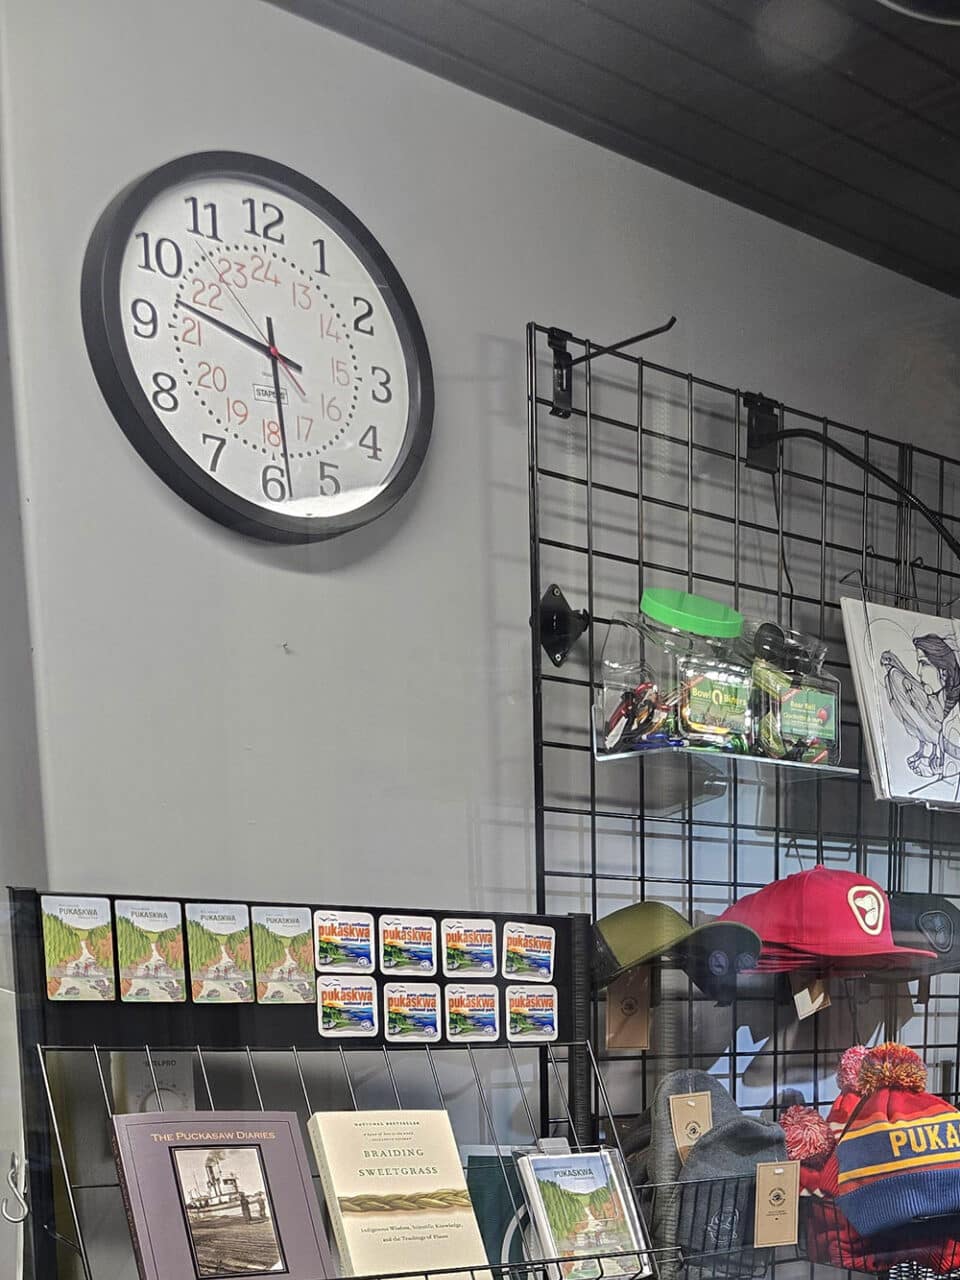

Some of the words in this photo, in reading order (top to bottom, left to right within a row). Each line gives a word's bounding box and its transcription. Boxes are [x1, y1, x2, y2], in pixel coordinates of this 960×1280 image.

[184, 195, 224, 243] 11
[241, 197, 285, 244] 12
[134, 231, 184, 279] 10
[312, 238, 331, 277] 1
[218, 258, 248, 289] 23
[250, 255, 282, 287] 24
[191, 278, 224, 312] 22
[292, 282, 312, 311] 13
[130, 298, 159, 339] 9
[320, 313, 342, 343] 14
[352, 297, 376, 337] 2
[181, 317, 203, 347] 21
[198, 362, 227, 393] 20
[331, 357, 350, 386] 15
[370, 366, 393, 403] 3
[150, 372, 179, 412] 8
[226, 399, 248, 426] 19
[321, 393, 342, 422] 16
[263, 418, 281, 447] 18
[296, 416, 314, 442] 17
[358, 424, 384, 462] 4
[202, 433, 227, 472] 7
[261, 464, 287, 503] 6
[318, 462, 341, 497] 5
[318, 923, 370, 938] pukaskwa
[382, 928, 432, 942] pukaskwa
[446, 930, 493, 944] pukaskwa
[507, 934, 552, 949] pukaskwa
[321, 988, 373, 1002] pukaskwa
[388, 995, 436, 1008] pukaskwa
[448, 996, 495, 1009] pukaskwa
[509, 996, 554, 1009] pukaskwa
[150, 1133, 174, 1142] THE
[236, 1130, 276, 1140] DIARIES
[363, 1148, 424, 1158] BRAIDING
[358, 1166, 438, 1177] SWEETGRASS
[553, 1168, 594, 1177] PUKASKWA
